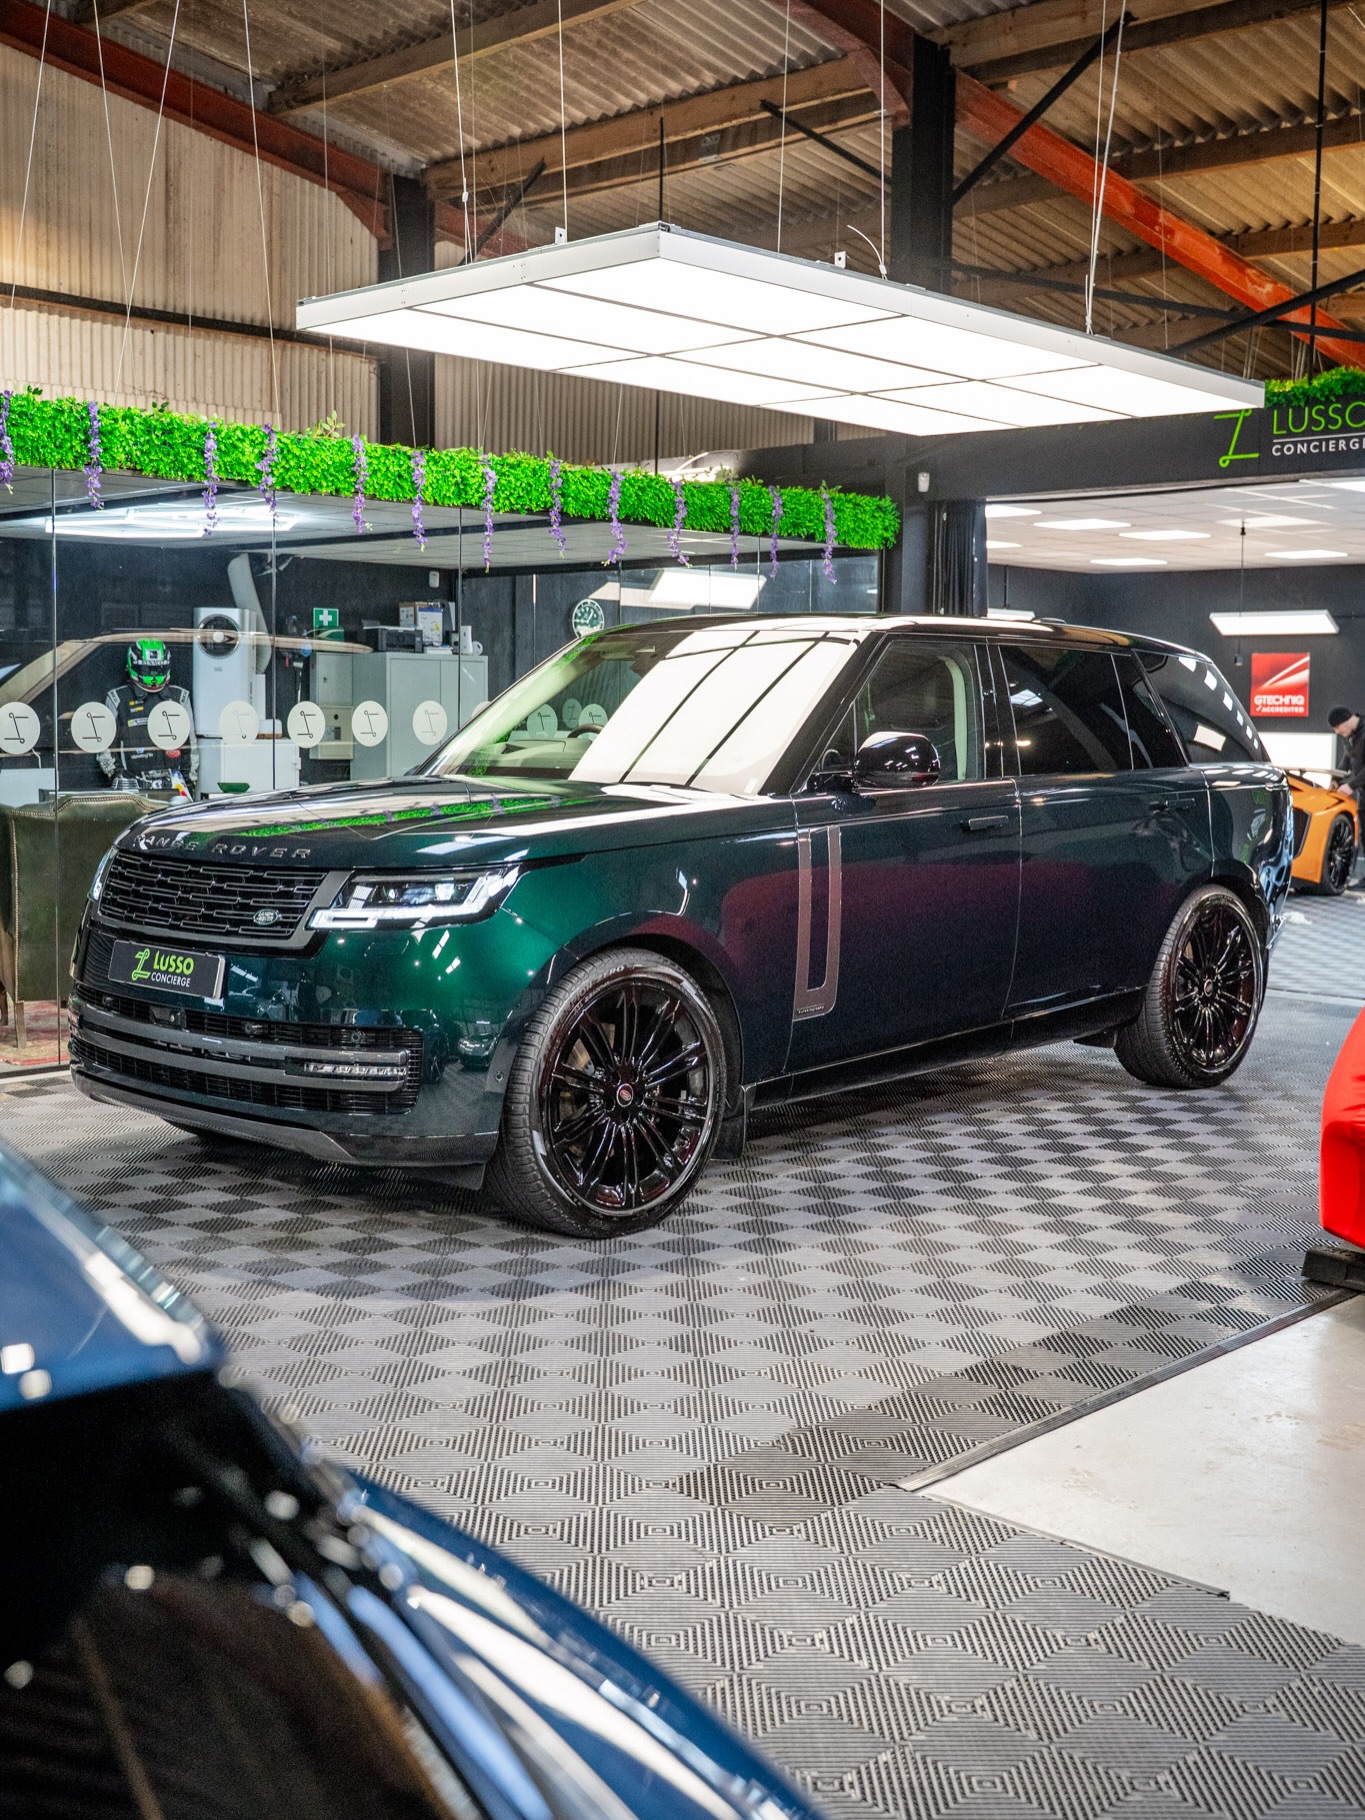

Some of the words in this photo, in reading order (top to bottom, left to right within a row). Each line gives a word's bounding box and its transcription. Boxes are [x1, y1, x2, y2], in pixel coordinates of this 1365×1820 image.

[212, 843, 311, 859] ROVER
[153, 952, 194, 975] LUSSO
[151, 971, 191, 988] CONCIERGE
